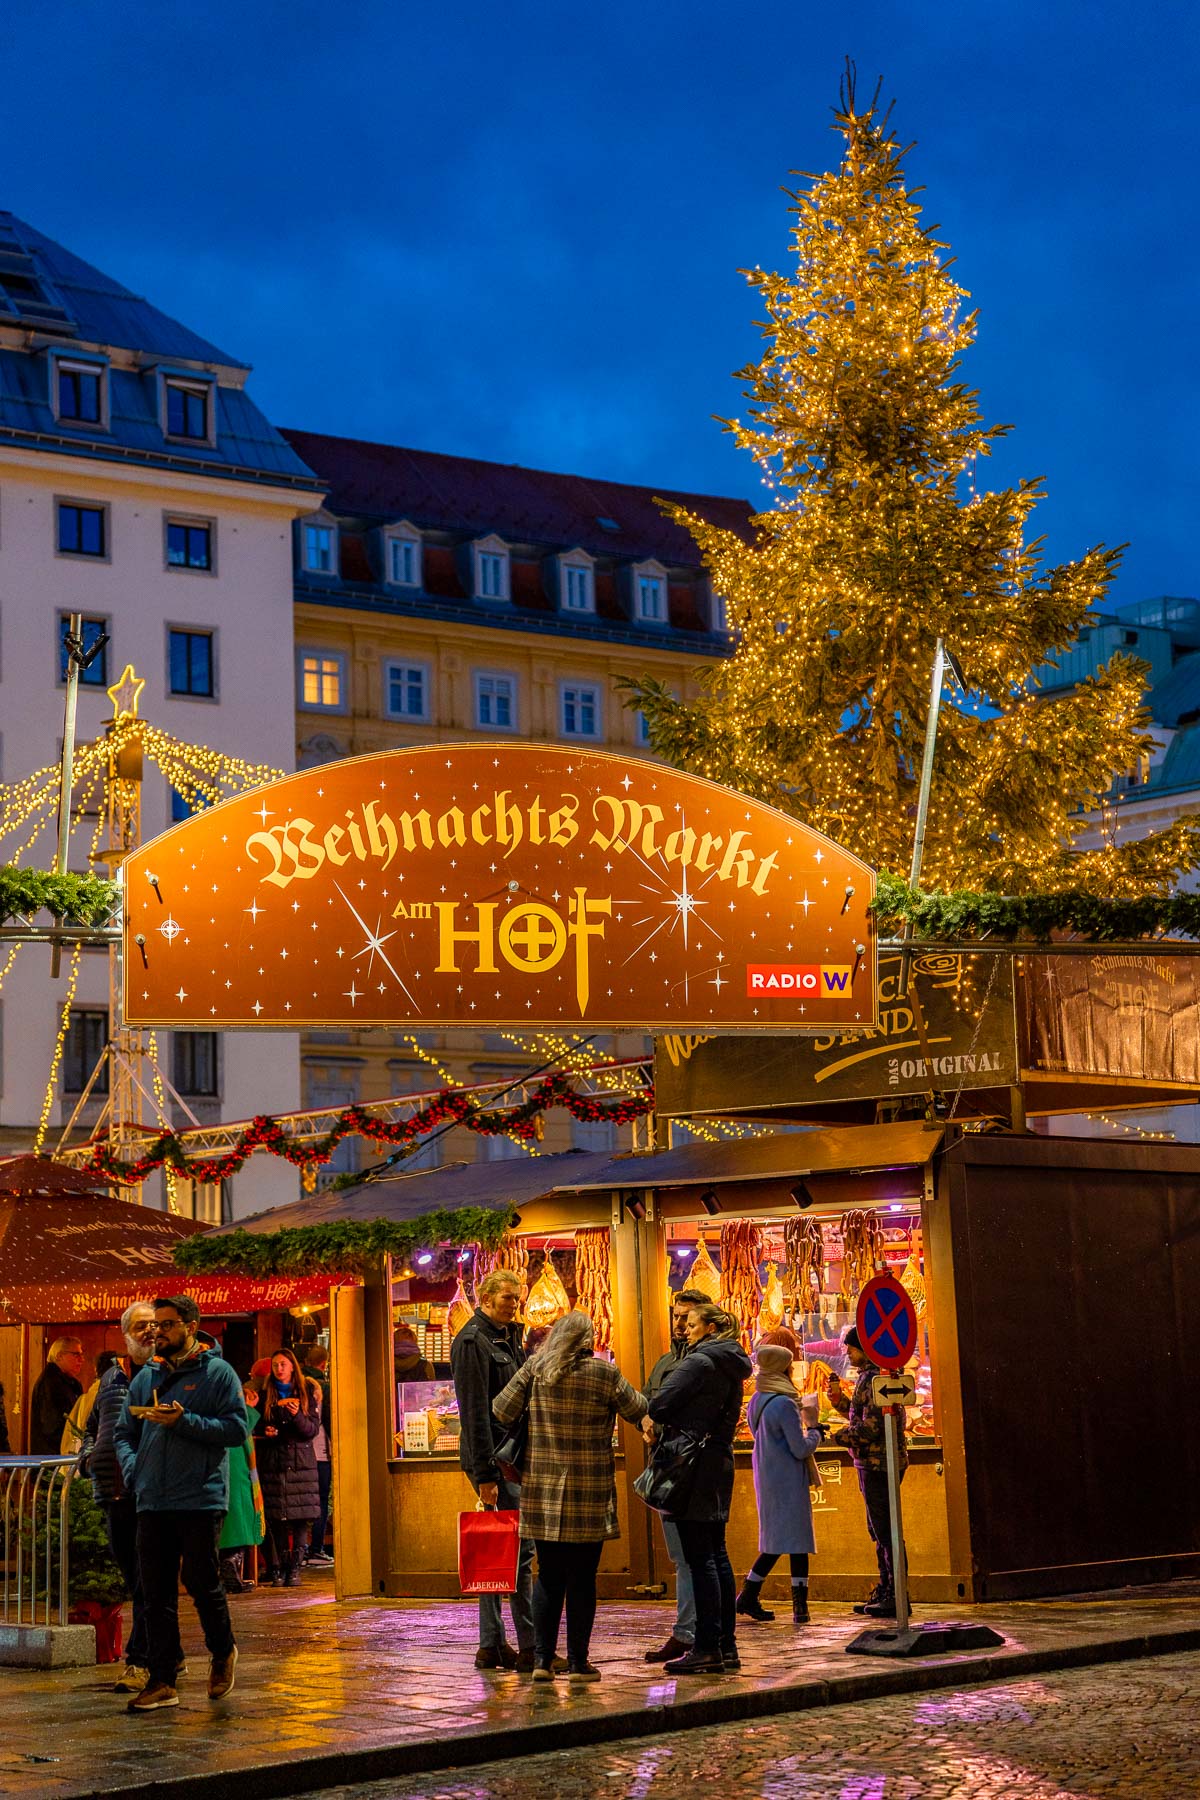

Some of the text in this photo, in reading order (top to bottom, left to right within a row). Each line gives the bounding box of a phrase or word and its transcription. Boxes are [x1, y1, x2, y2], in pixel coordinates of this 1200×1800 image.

[246, 790, 779, 897] Weihnachts Markt
[433, 887, 612, 1017] HOF
[751, 971, 849, 991] RADIO W
[900, 1052, 1005, 1079] ORIGINAL
